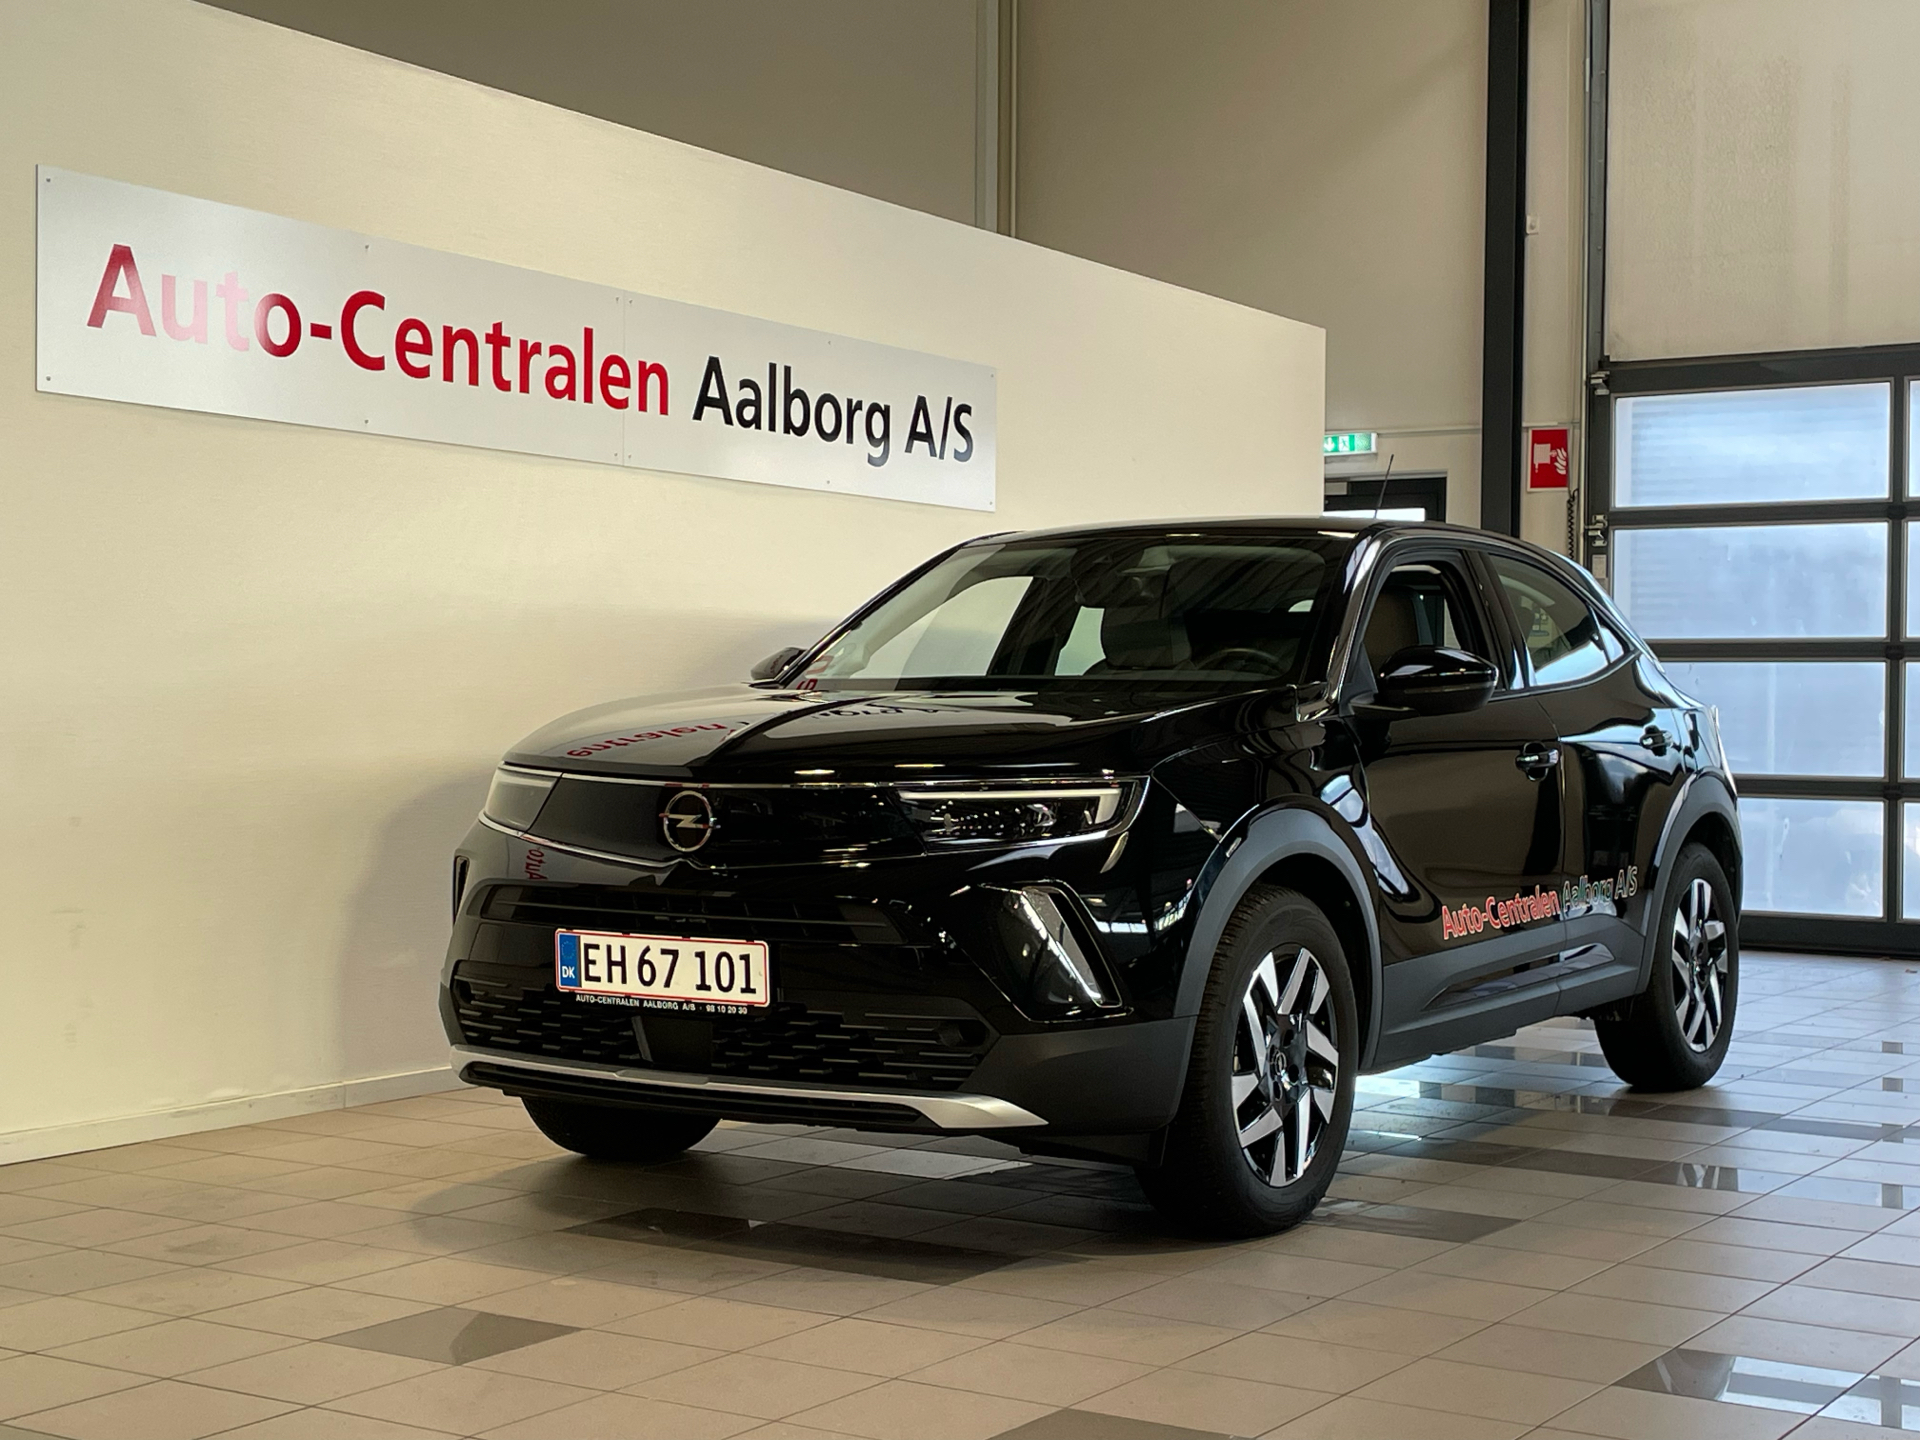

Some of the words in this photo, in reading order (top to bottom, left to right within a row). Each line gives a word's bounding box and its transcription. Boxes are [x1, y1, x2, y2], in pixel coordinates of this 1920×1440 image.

[87, 243, 670, 415] Auto-Centralen
[692, 355, 891, 467] Aalborg
[904, 394, 974, 462] A/S
[1441, 884, 1561, 940] Auto-Centralen
[1562, 874, 1614, 912] Aalborg
[1614, 865, 1638, 900] A/S
[561, 965, 576, 979] DK
[583, 942, 628, 985] EH
[637, 945, 680, 988] 67
[694, 950, 757, 994] 101
[575, 994, 640, 1007] AUTO-CENTRALEN
